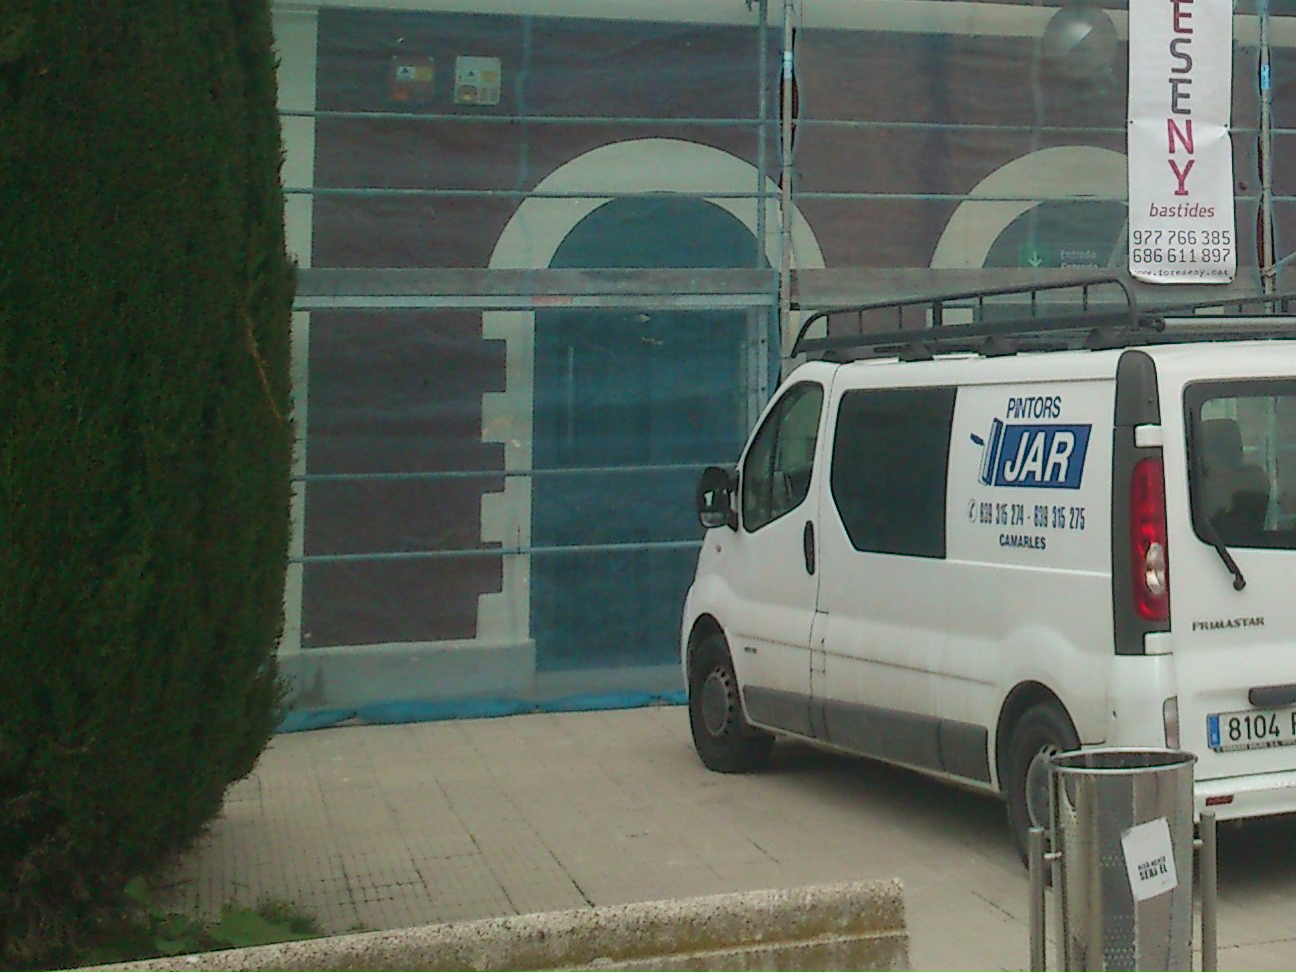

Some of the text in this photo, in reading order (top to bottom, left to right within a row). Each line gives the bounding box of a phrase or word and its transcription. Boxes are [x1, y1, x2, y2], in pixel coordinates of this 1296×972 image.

[1149, 202, 1215, 218] bastides
[1133, 230, 1231, 245] 977 766 385
[1133, 248, 1231, 263] 686 611 897
[1006, 396, 1062, 419] PINTORS
[1003, 430, 1076, 483] JAR
[1069, 506, 1086, 530] 275
[999, 533, 1046, 550] CAMARLES
[1192, 616, 1265, 631] PRIMASTAR
[1228, 712, 1281, 741] 8104
